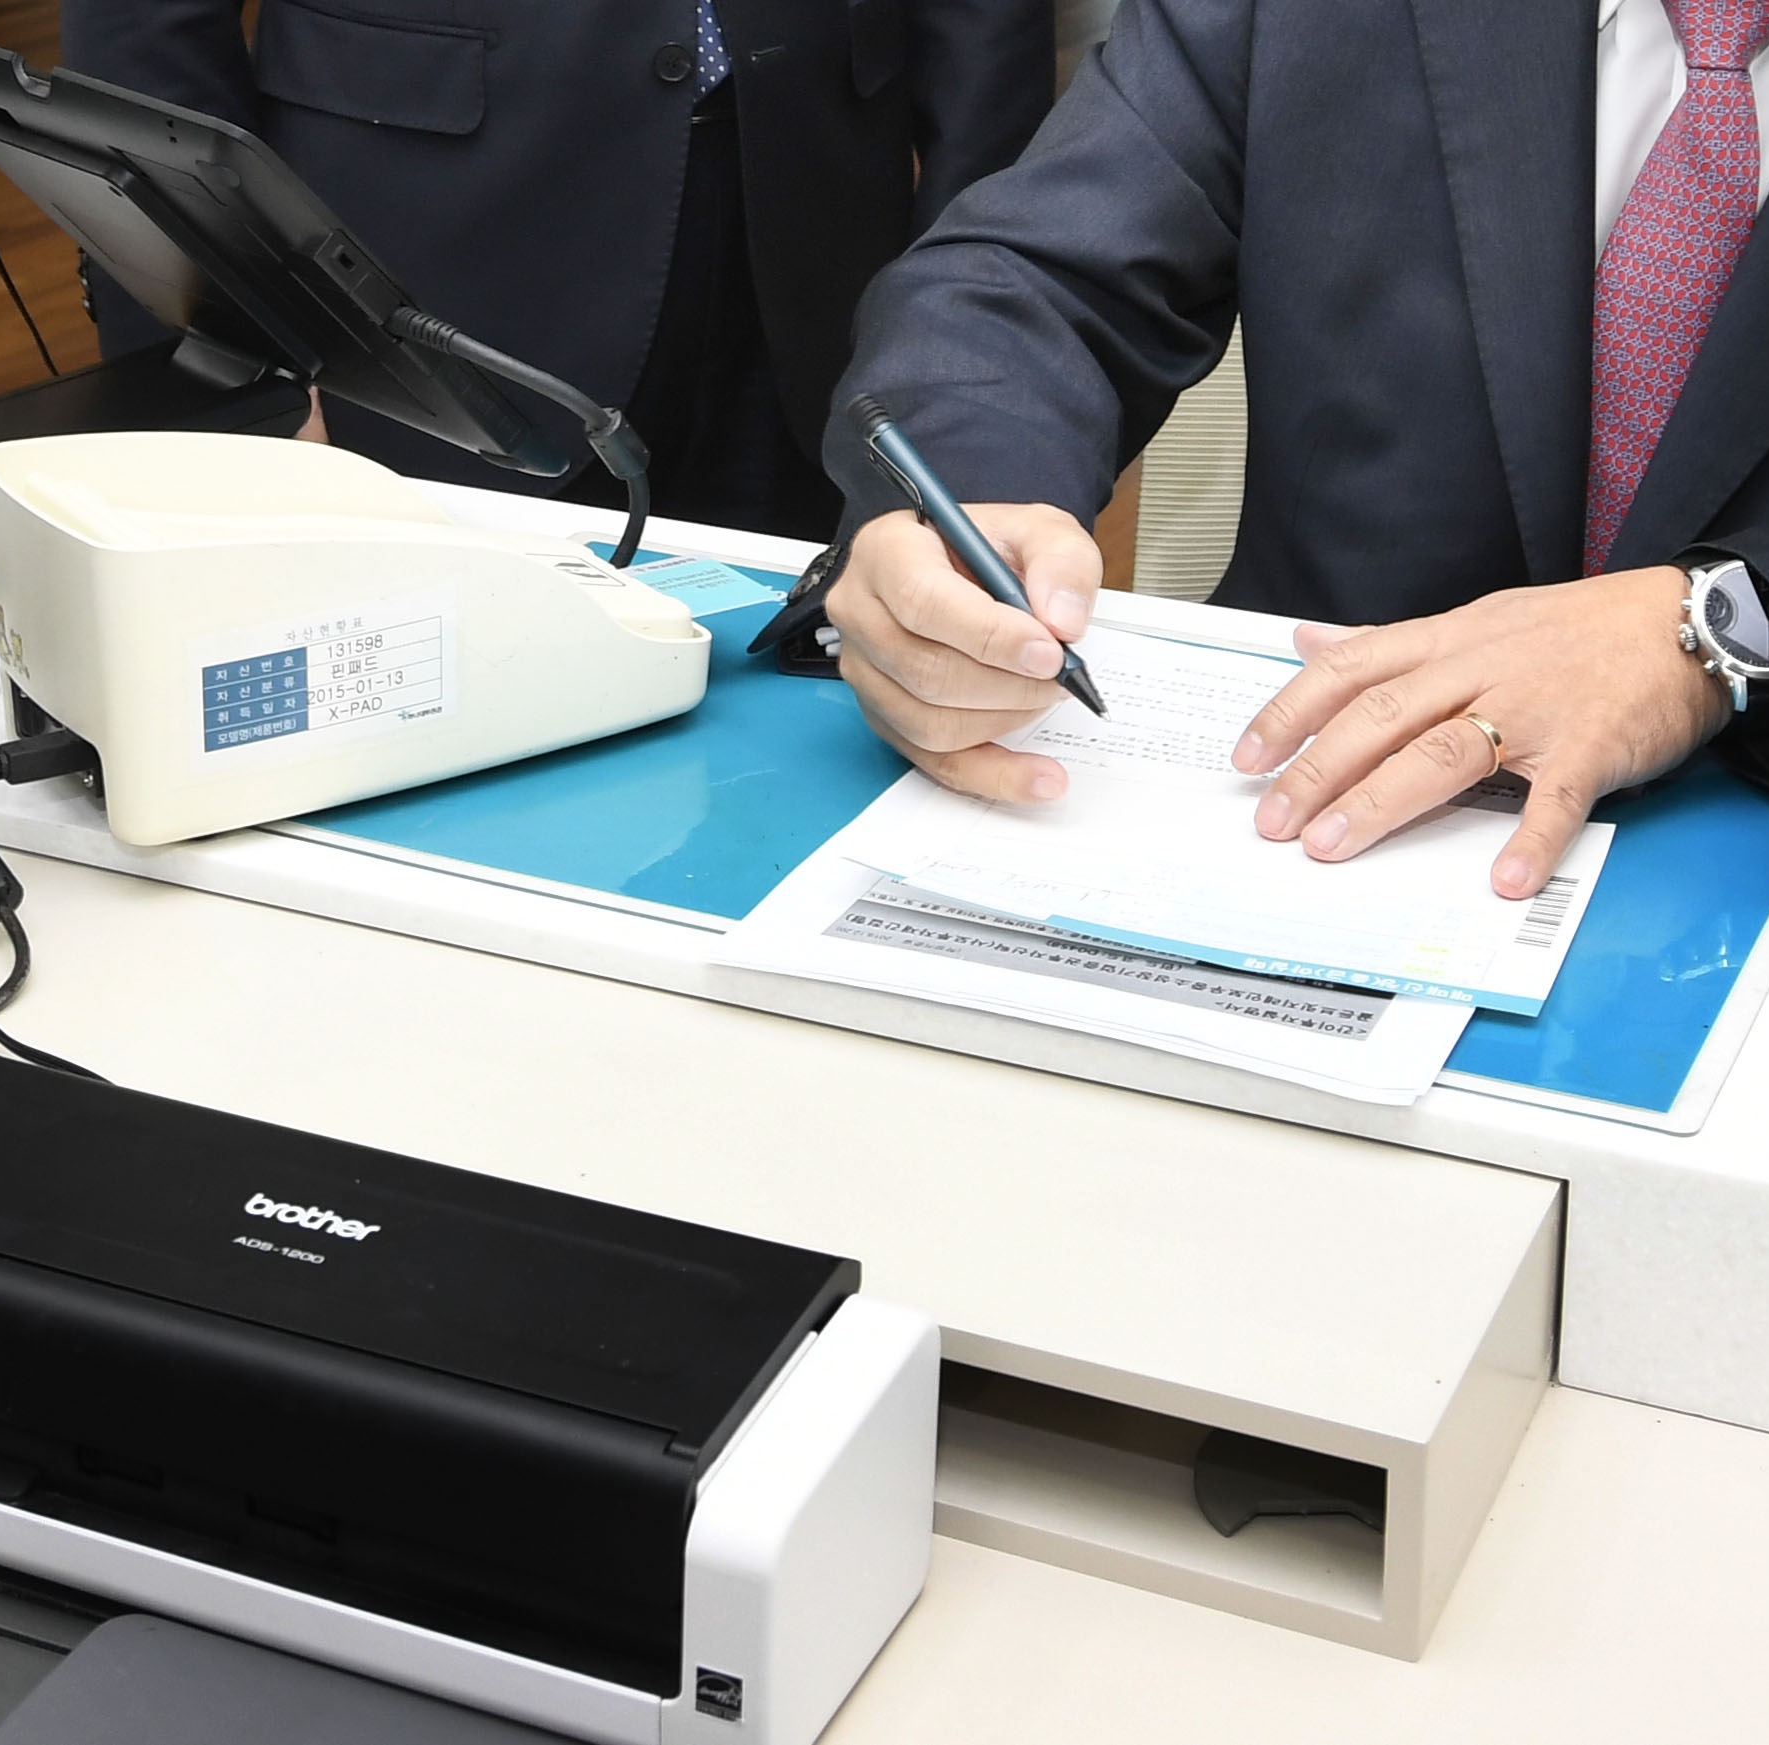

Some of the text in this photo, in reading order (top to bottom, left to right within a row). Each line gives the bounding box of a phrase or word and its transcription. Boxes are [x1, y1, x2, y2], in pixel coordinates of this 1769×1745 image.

[326, 634, 384, 660] 131598
[330, 655, 379, 679] 핀패드
[307, 670, 405, 706] 2015-01-13
[328, 696, 384, 721] X-PAD
[245, 1193, 381, 1241] brother
[233, 1236, 325, 1264] ADS-1200
